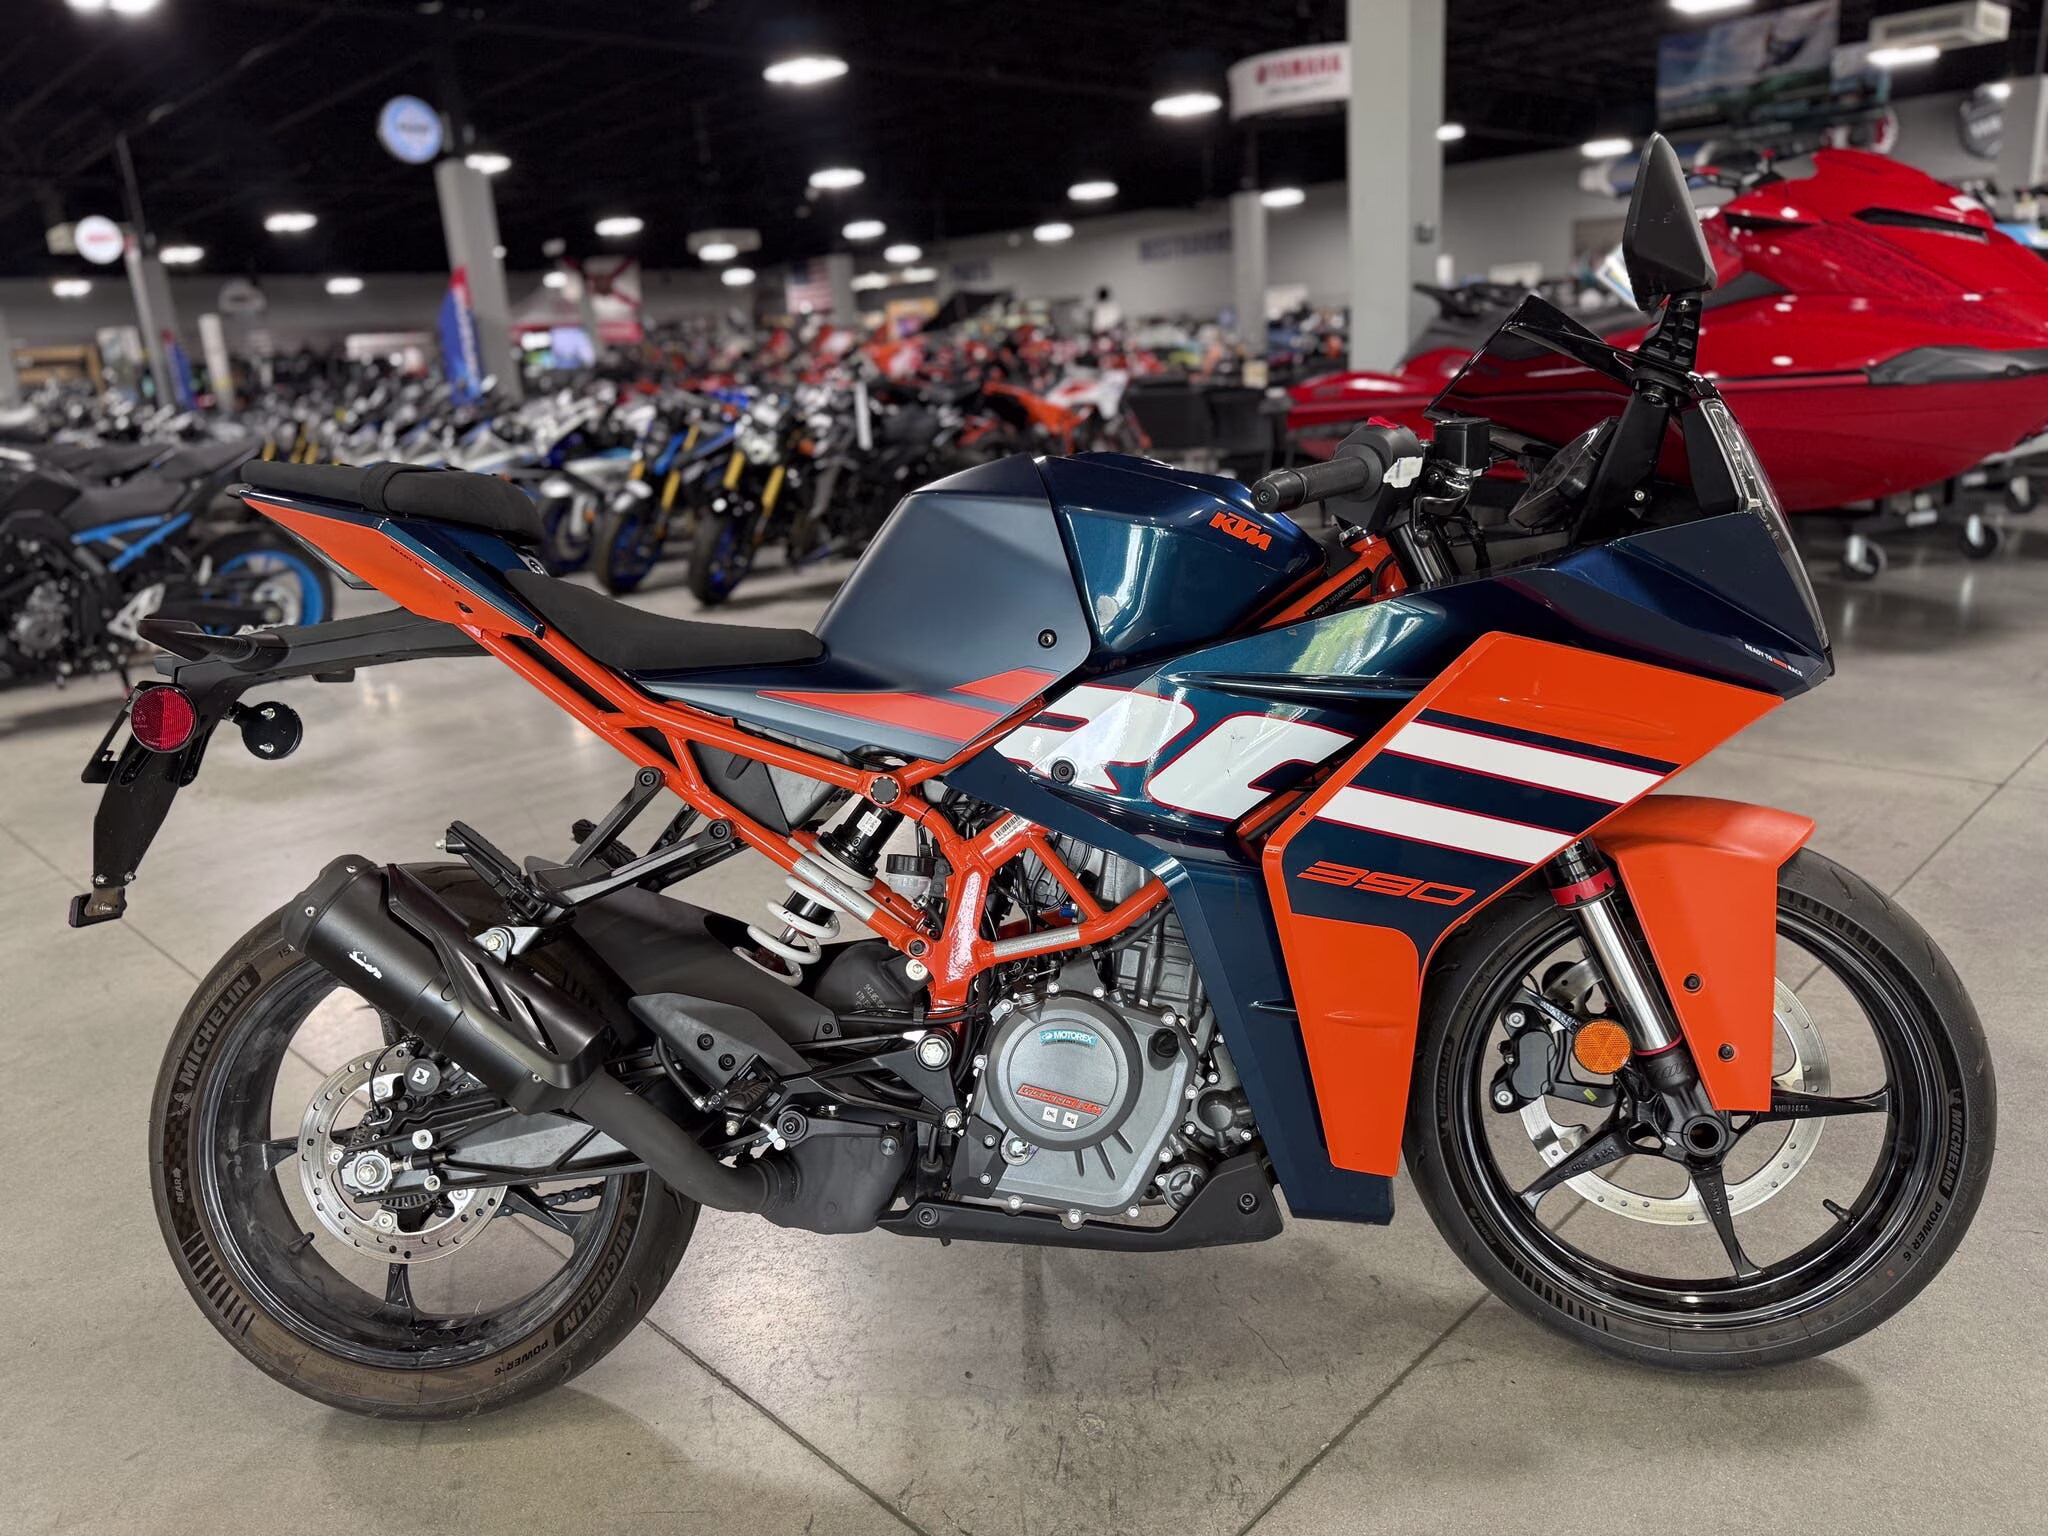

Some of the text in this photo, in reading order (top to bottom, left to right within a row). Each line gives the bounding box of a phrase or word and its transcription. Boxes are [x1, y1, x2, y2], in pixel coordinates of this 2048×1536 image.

[1209, 511, 1272, 551] KTM
[1744, 643, 1764, 657] READY
[1787, 664, 1803, 677] RACE
[992, 683, 1359, 823] RC
[1297, 860, 1476, 906] 390
[178, 975, 252, 1088] MICHELIN
[1053, 1030, 1093, 1043] MOTOREX
[1438, 1043, 1453, 1118] MICHELIN
[1941, 1108, 1963, 1192] MICHELIN
[174, 1178, 185, 1203] REAR
[1902, 1200, 1944, 1262] POWER 6
[562, 1223, 633, 1335] MICHELIN
[506, 1339, 549, 1371] POWER
